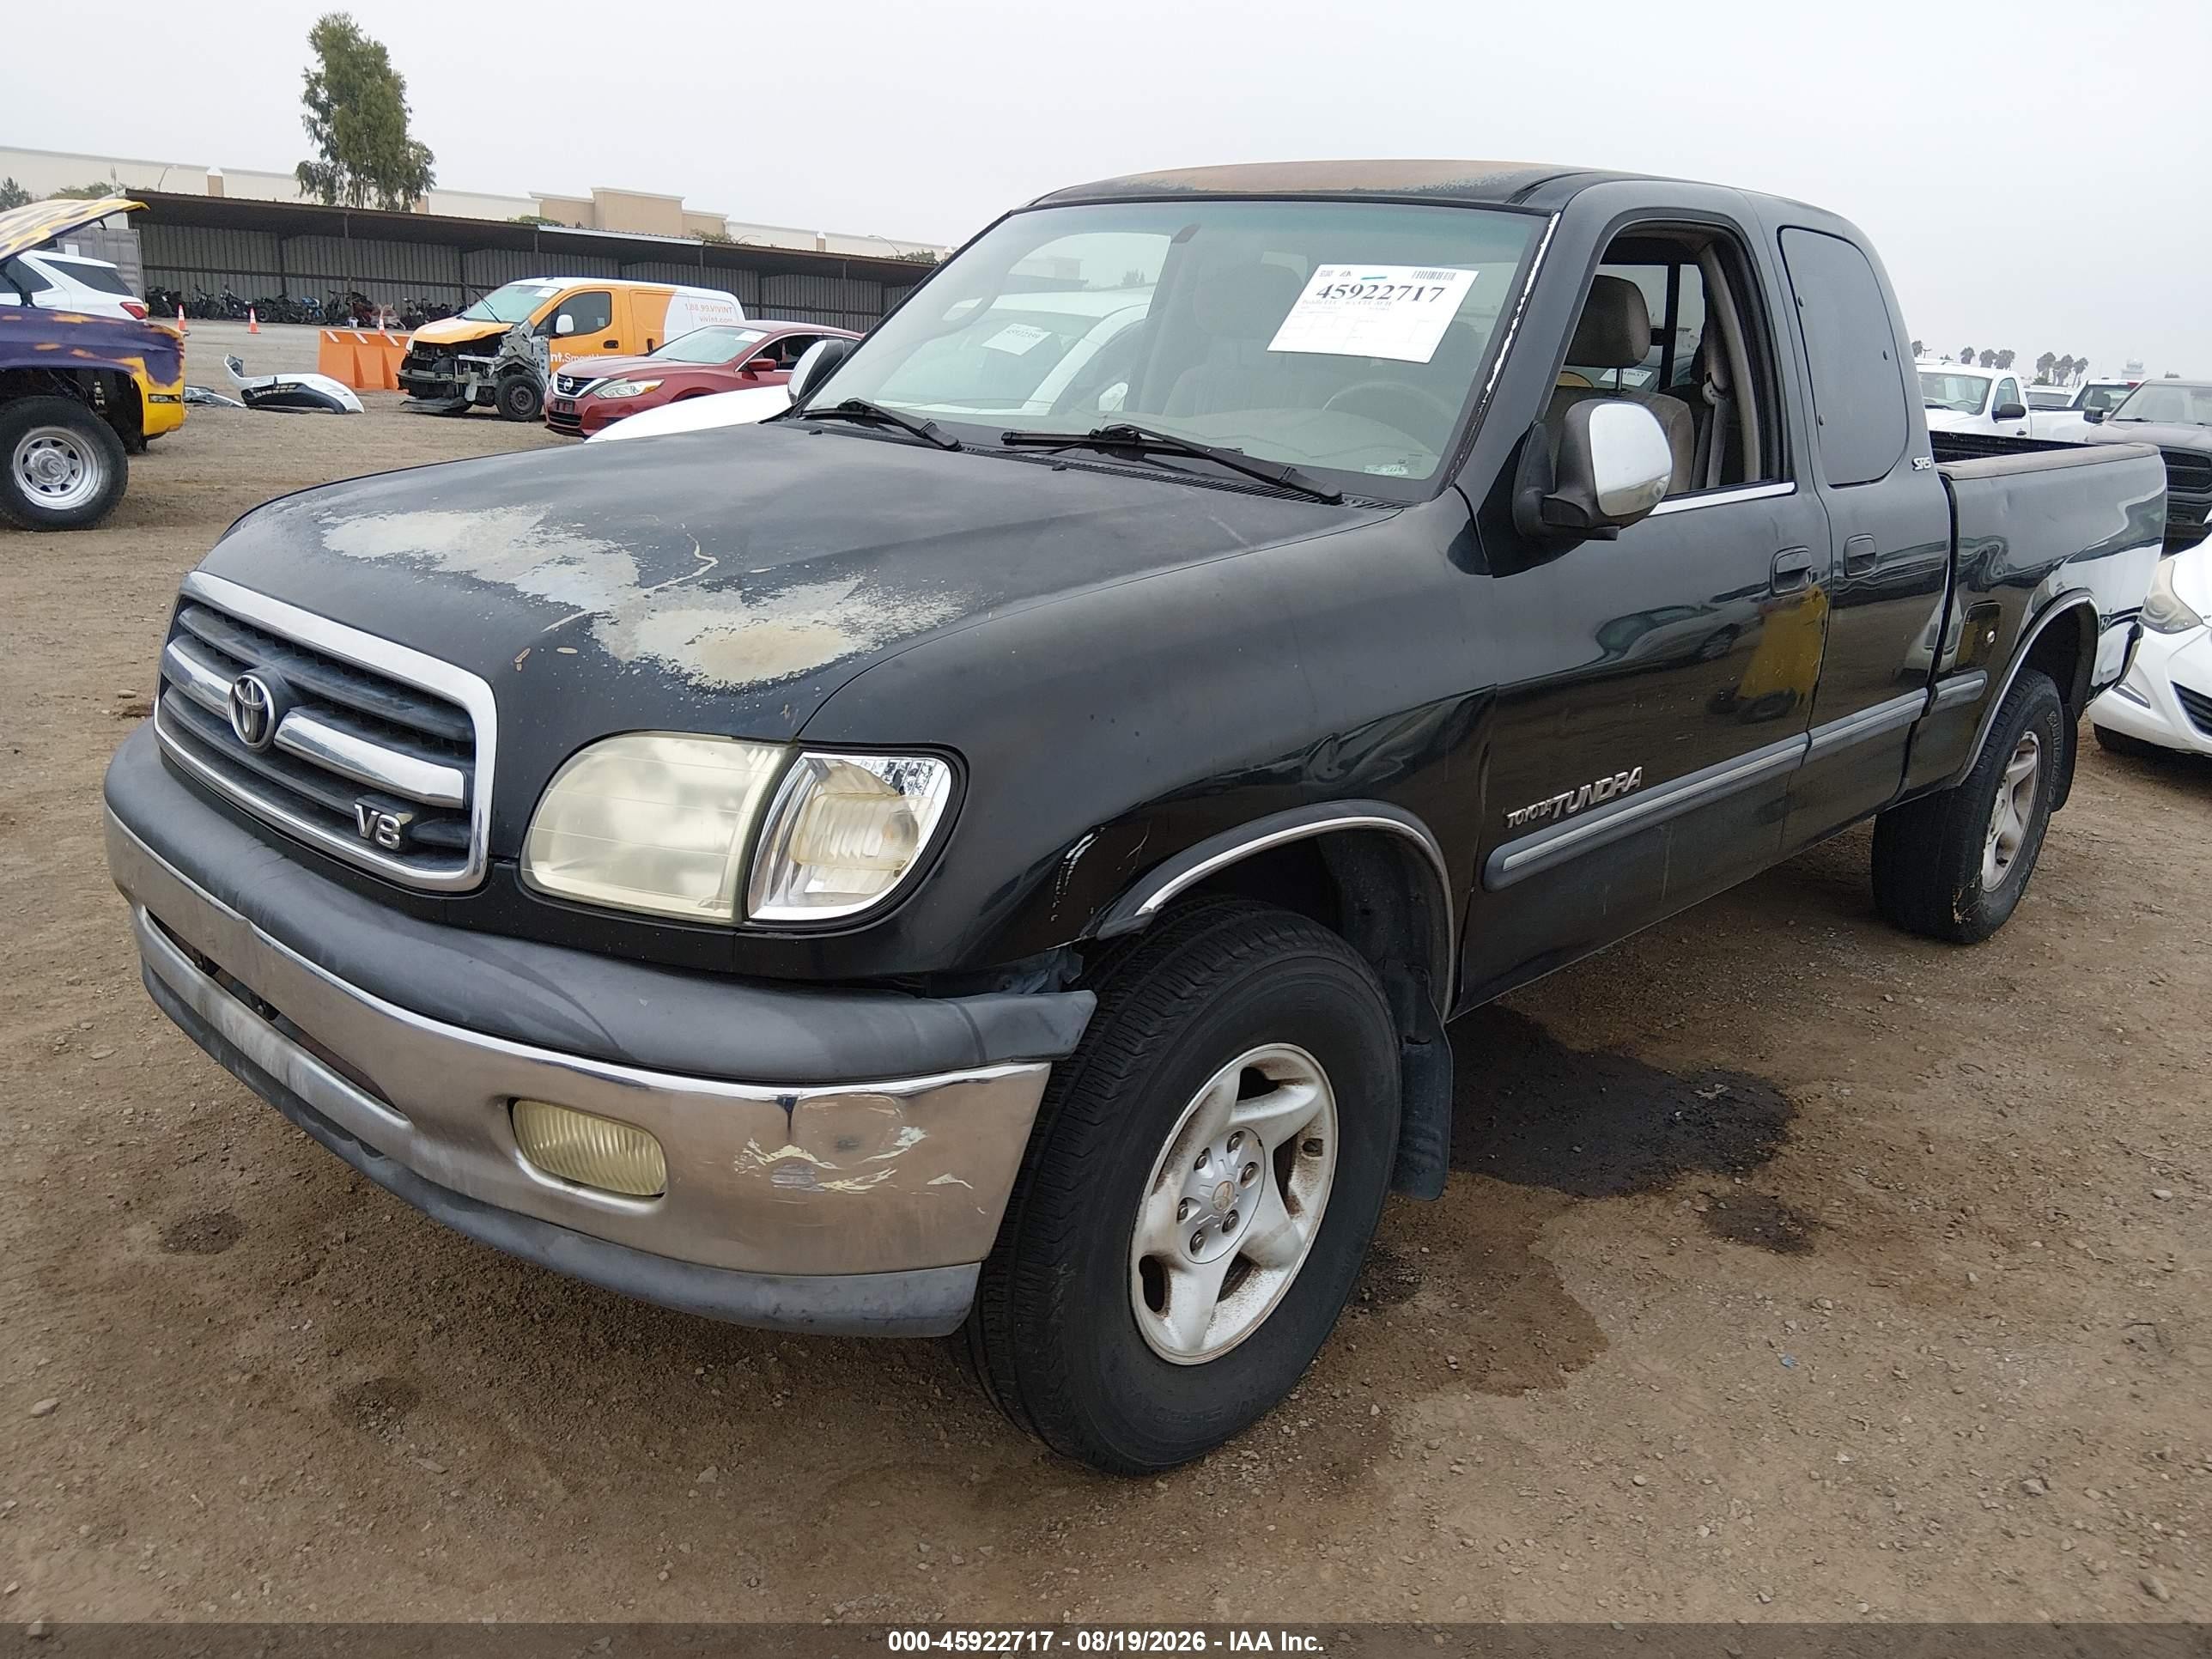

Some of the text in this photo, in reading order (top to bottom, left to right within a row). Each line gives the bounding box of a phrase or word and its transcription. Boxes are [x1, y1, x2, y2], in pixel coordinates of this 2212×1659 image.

[1316, 283, 1447, 303] 45922717
[1506, 766, 1643, 829] TOYOTA TUNDRA
[353, 803, 401, 850] V8
